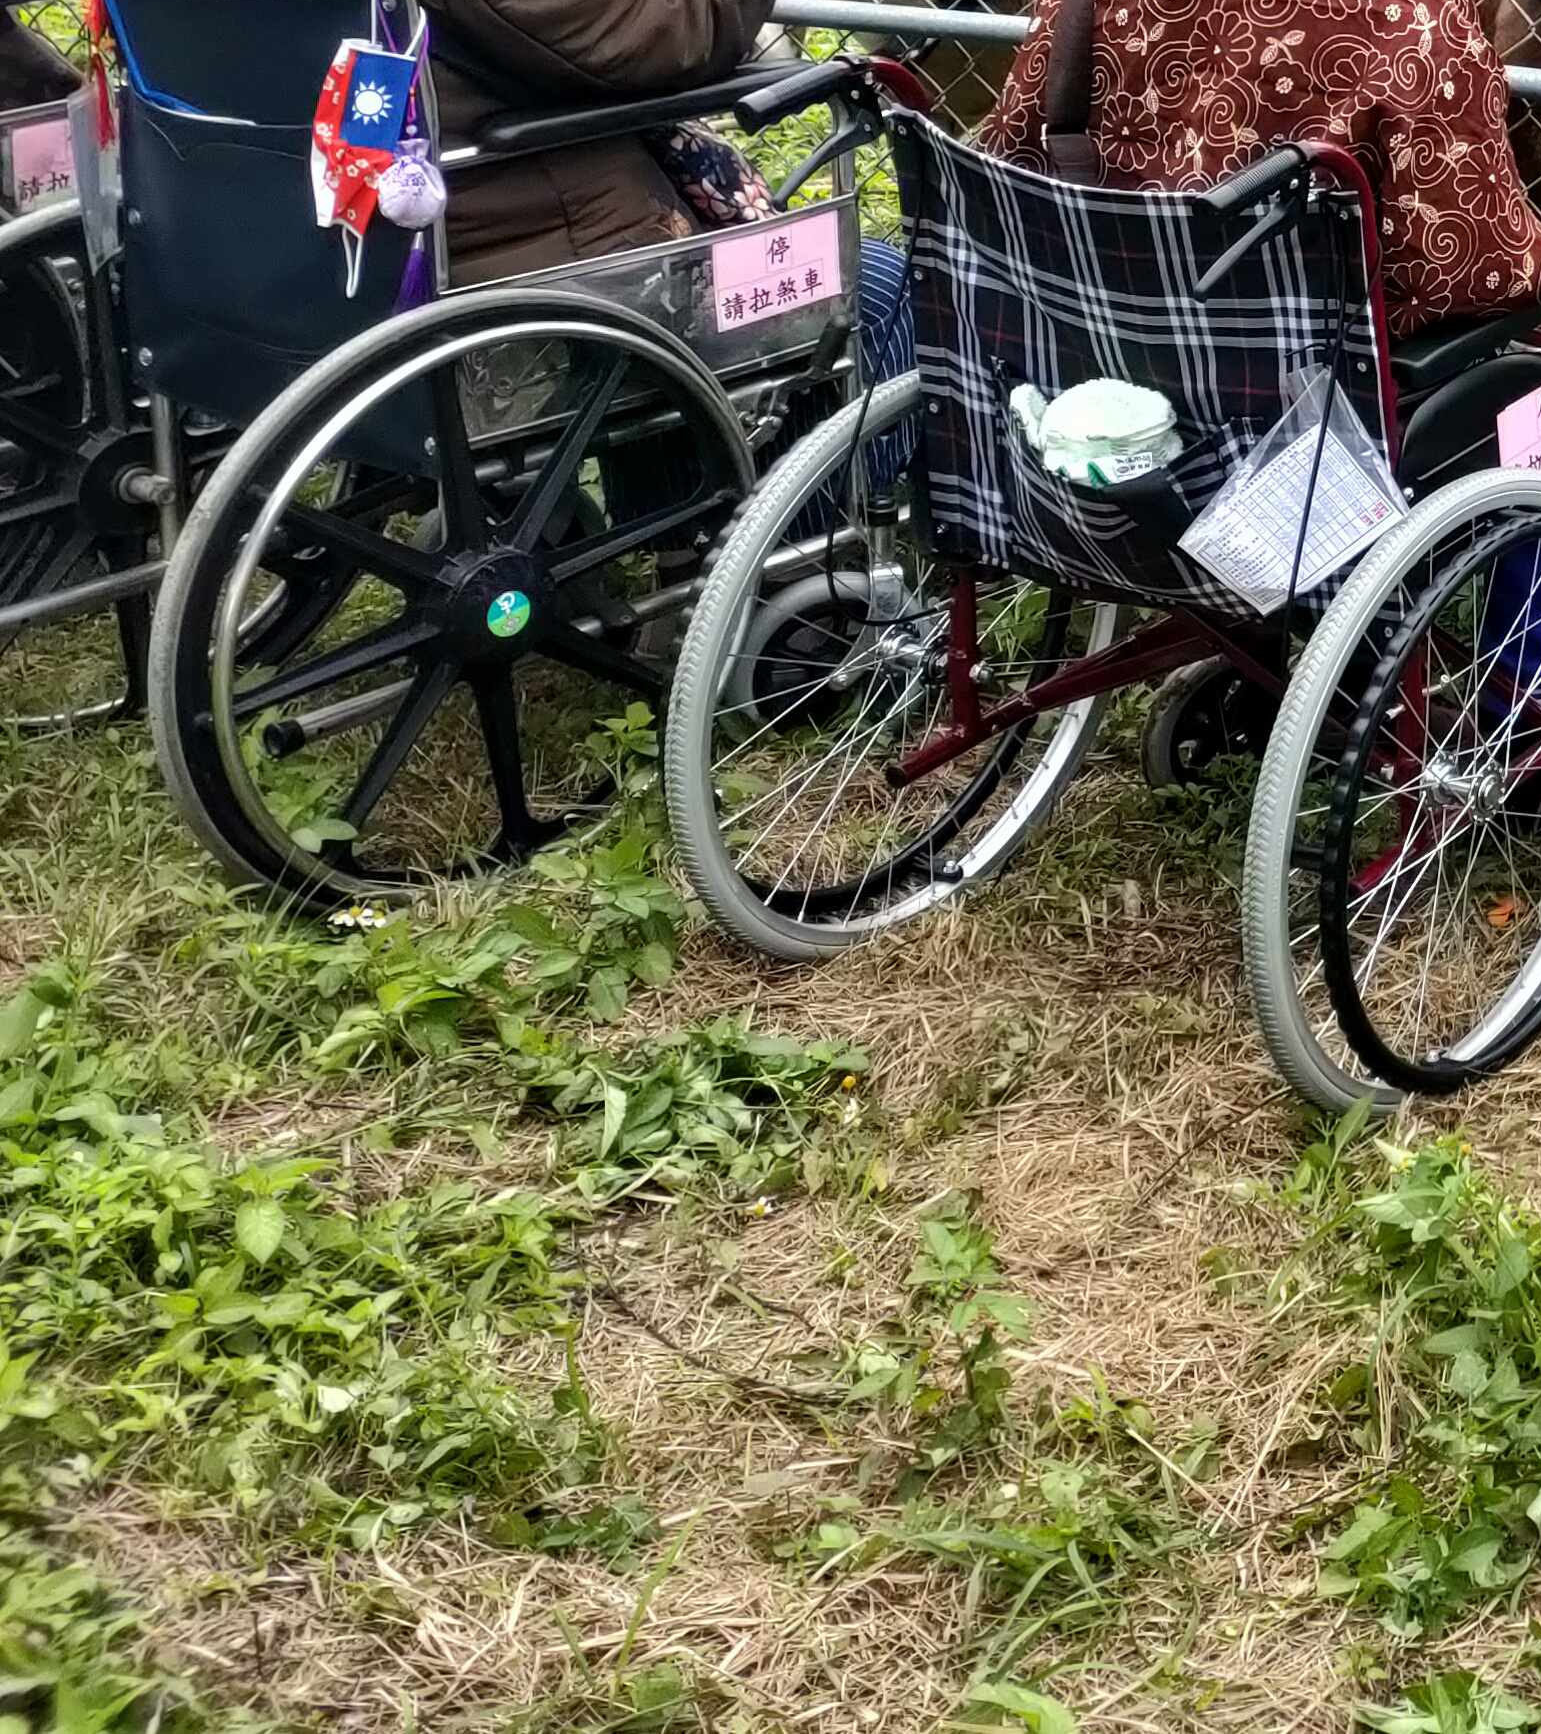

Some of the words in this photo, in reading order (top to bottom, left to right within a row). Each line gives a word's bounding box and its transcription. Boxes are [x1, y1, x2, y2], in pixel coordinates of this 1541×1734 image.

[766, 236, 790, 264] 停
[721, 268, 822, 321] 請拉煞車
